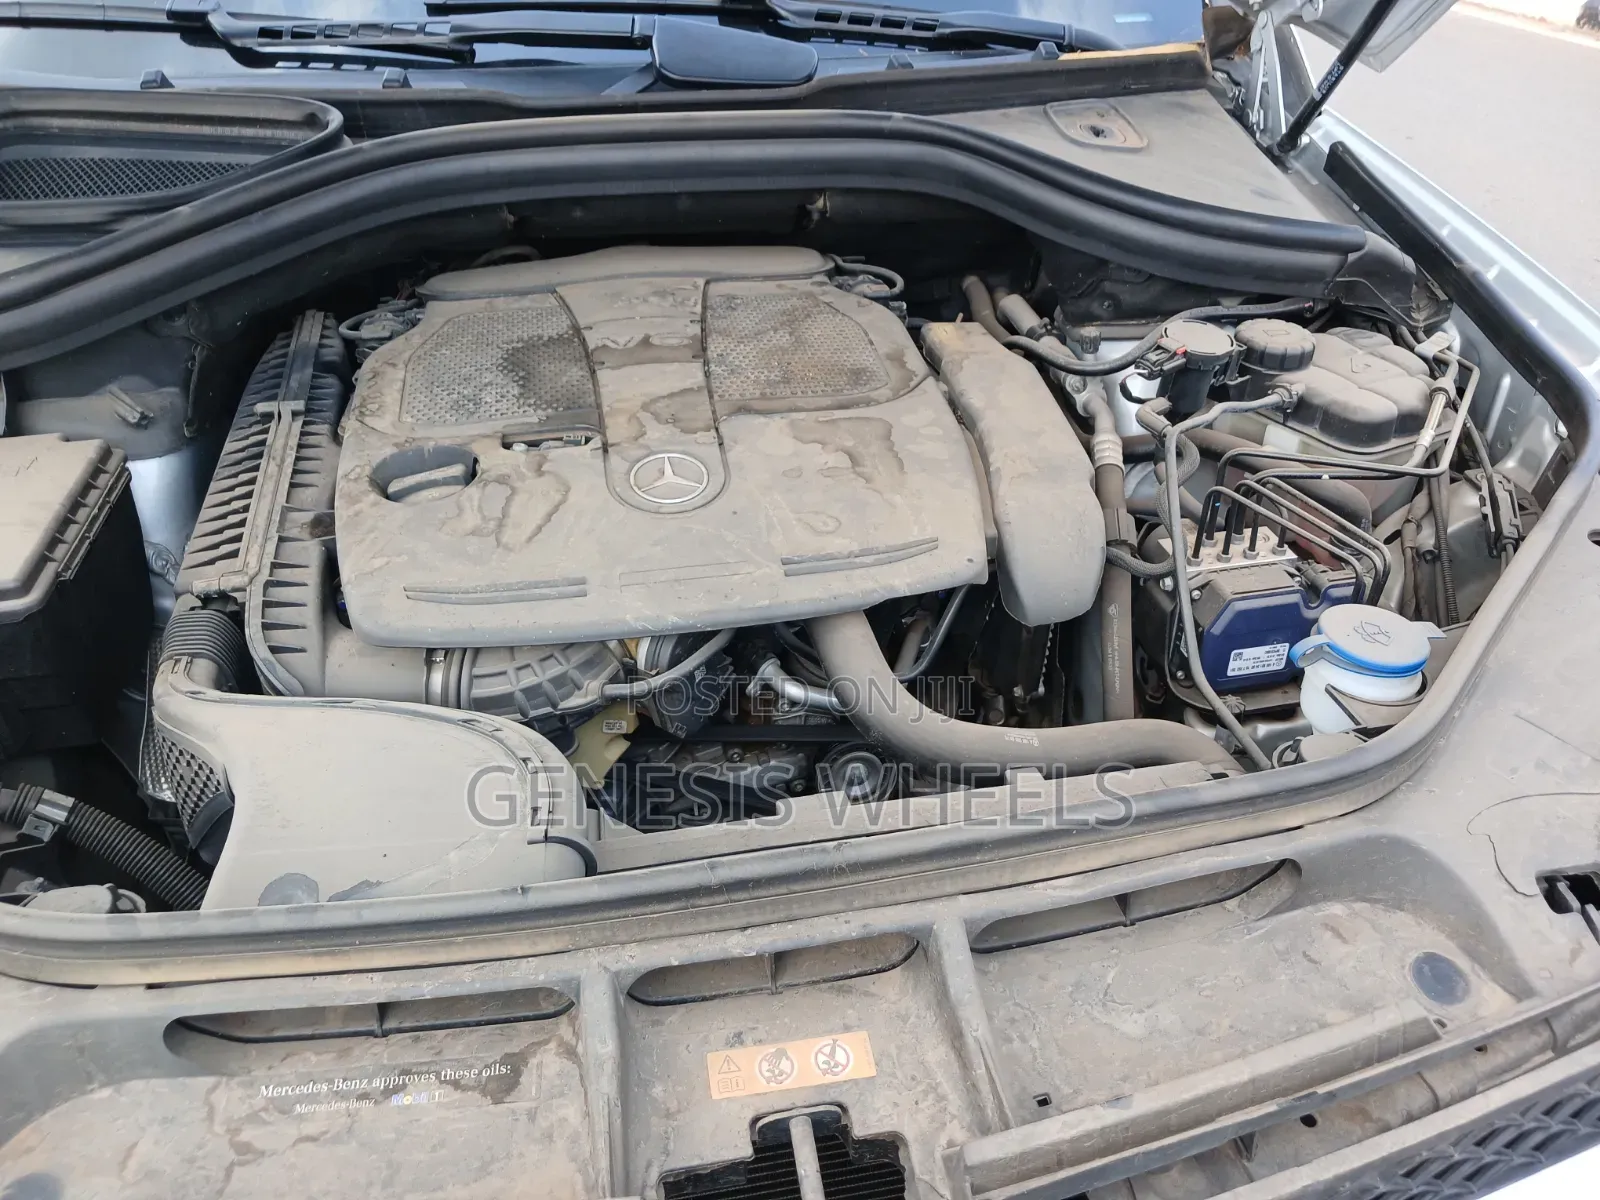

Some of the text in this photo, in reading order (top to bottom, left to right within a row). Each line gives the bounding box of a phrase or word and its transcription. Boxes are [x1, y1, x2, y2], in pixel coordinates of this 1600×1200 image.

[257, 1063, 511, 1098] Mercedes-Benz approves these oils:
[293, 1098, 376, 1114] Mercedes-Benz
[391, 1091, 429, 1106] Mobil
